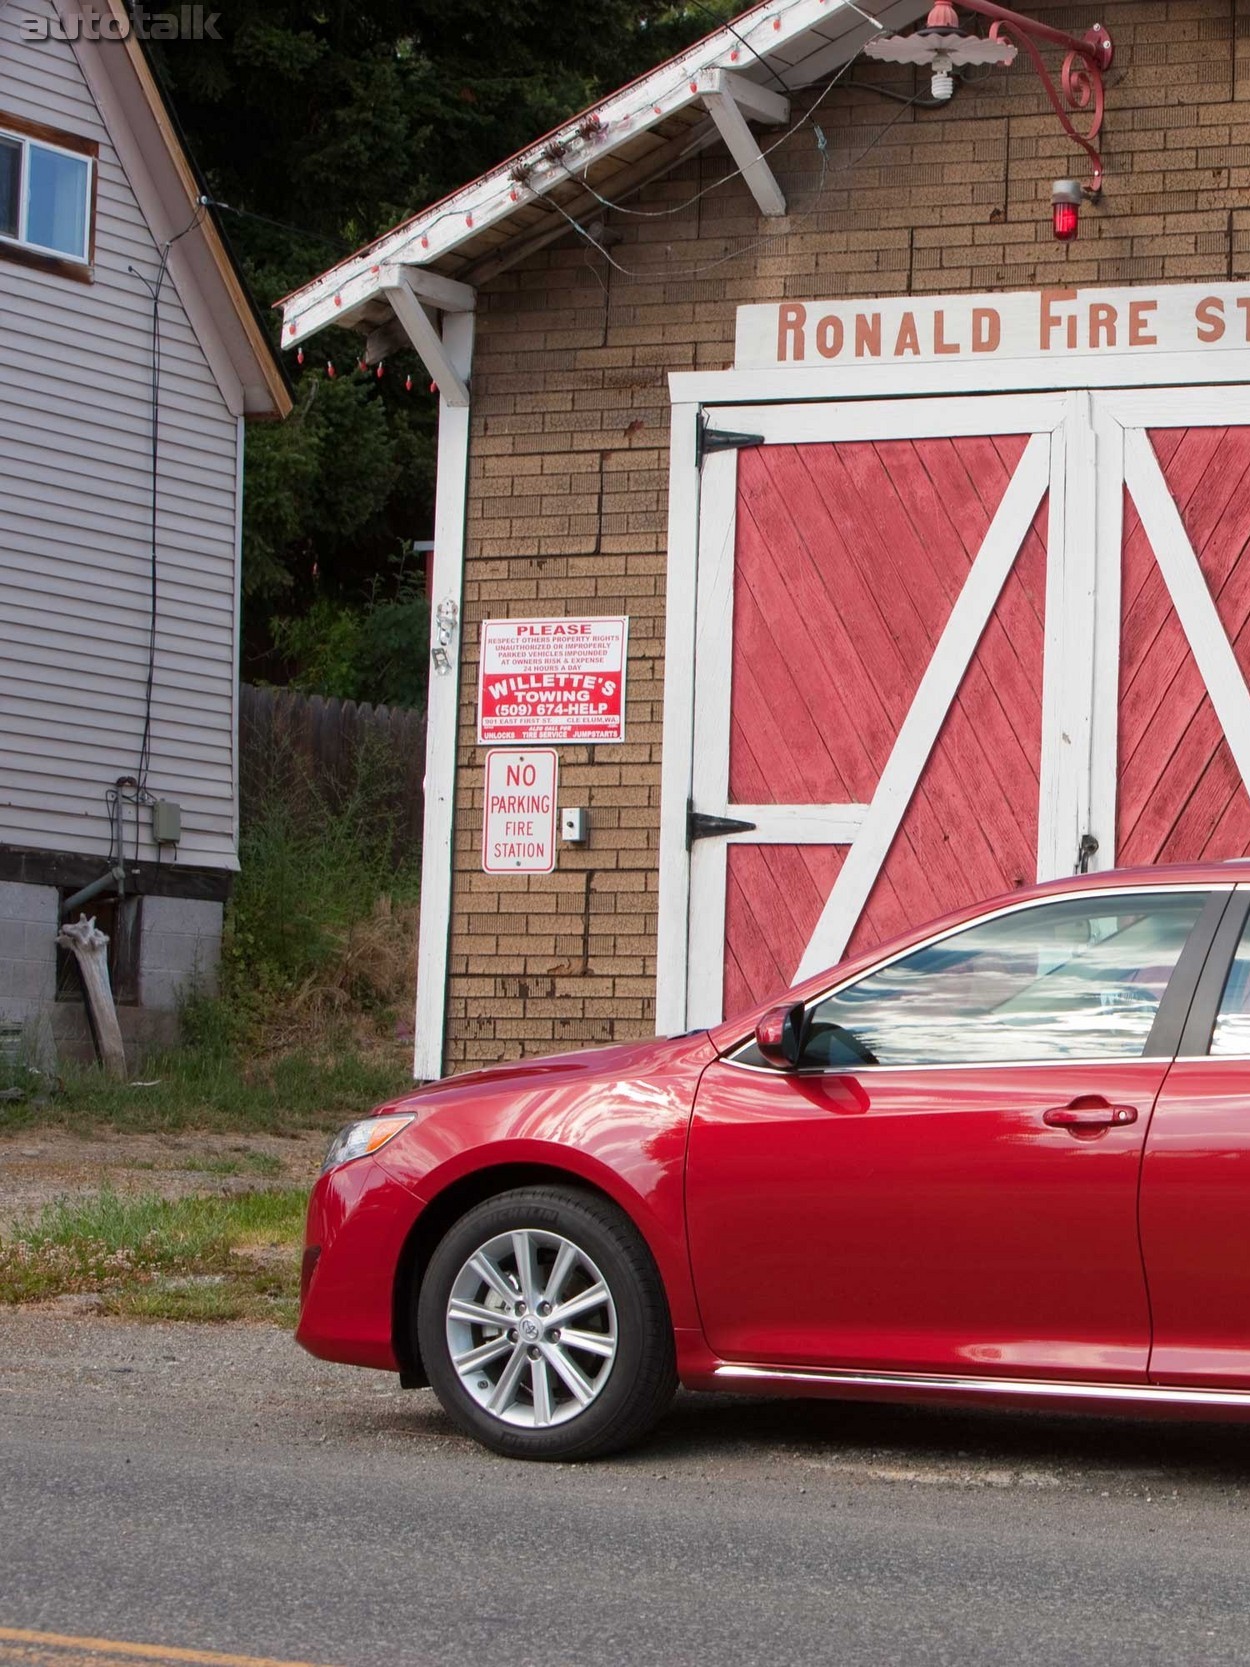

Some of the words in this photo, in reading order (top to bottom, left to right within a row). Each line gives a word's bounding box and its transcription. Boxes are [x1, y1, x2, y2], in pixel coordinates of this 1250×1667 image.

[776, 302, 1000, 362] RONALD
[1039, 290, 1158, 350] FIRE
[517, 624, 591, 636] PLEASE
[488, 674, 616, 700] WILLETTE'S
[514, 690, 590, 702] TOWING
[495, 704, 532, 716] (509)
[536, 703, 608, 715] 674-HELP
[573, 730, 618, 738] JUMPSTARTS
[506, 765, 535, 786] NO
[491, 795, 550, 813] PARKING
[506, 821, 533, 836] FIRE
[494, 842, 544, 858] STATION
